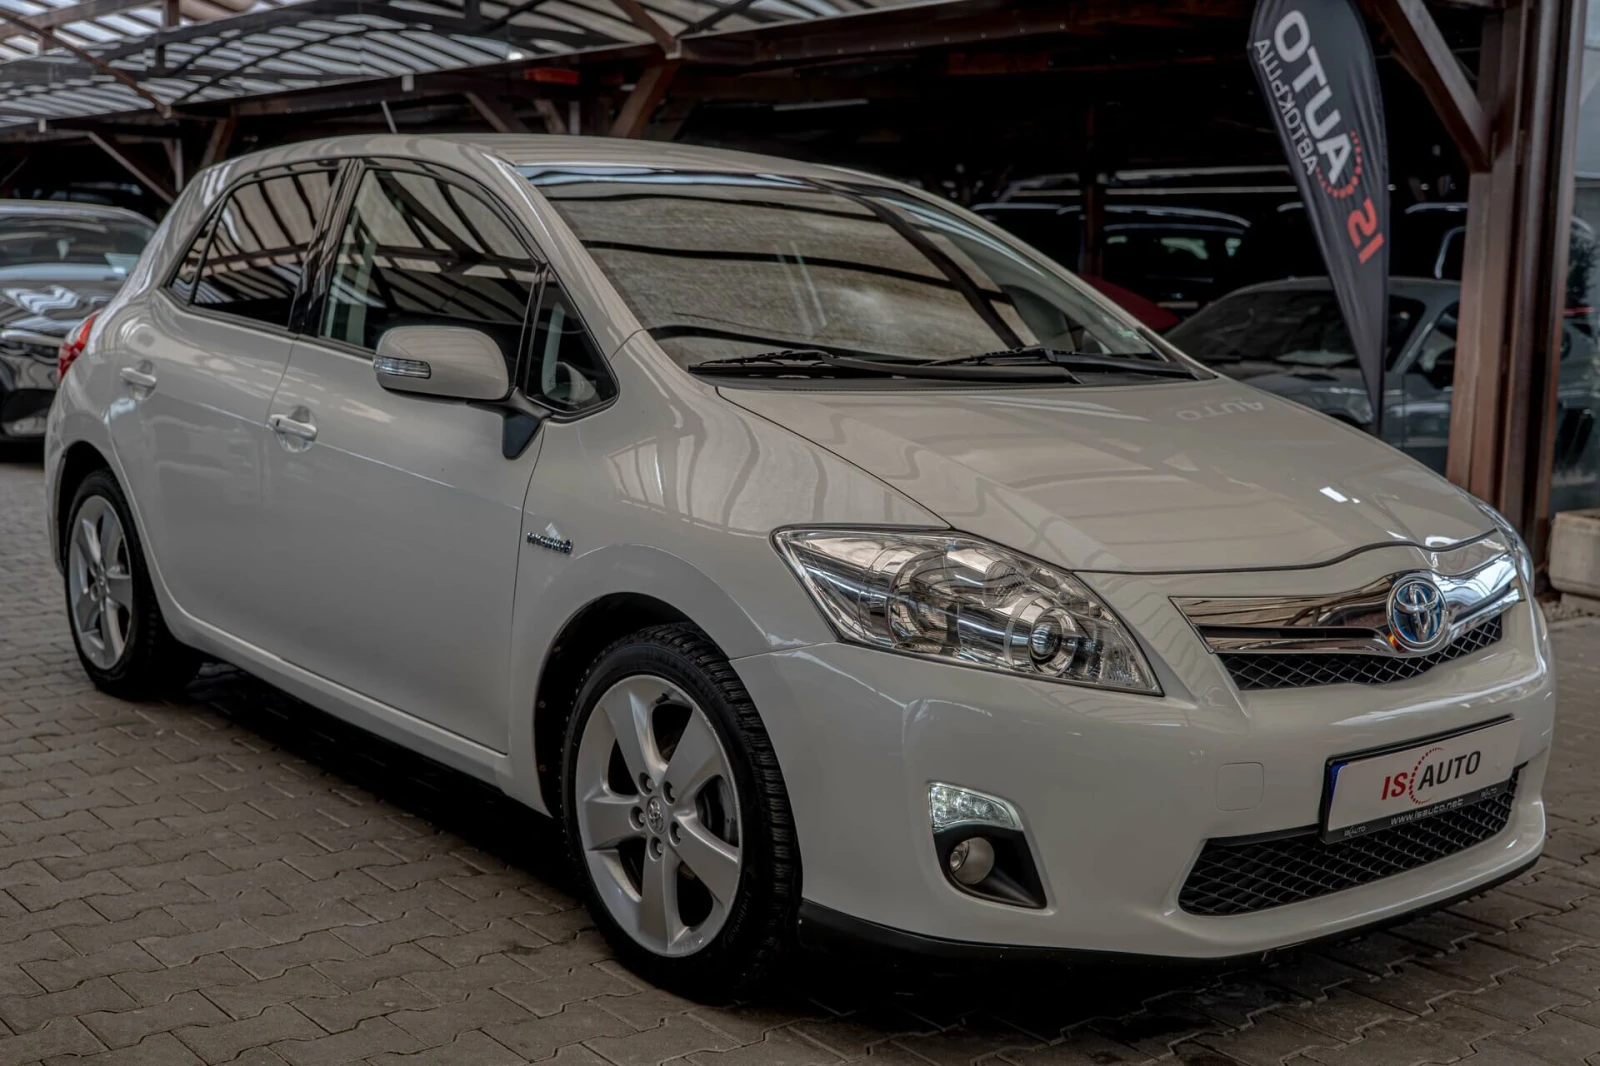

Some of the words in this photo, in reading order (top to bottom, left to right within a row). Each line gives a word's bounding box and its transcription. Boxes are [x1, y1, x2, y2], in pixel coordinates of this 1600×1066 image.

[1381, 772, 1408, 800] IS
[1417, 750, 1481, 791] AUTO
[1390, 797, 1464, 826] www.isauto.net
